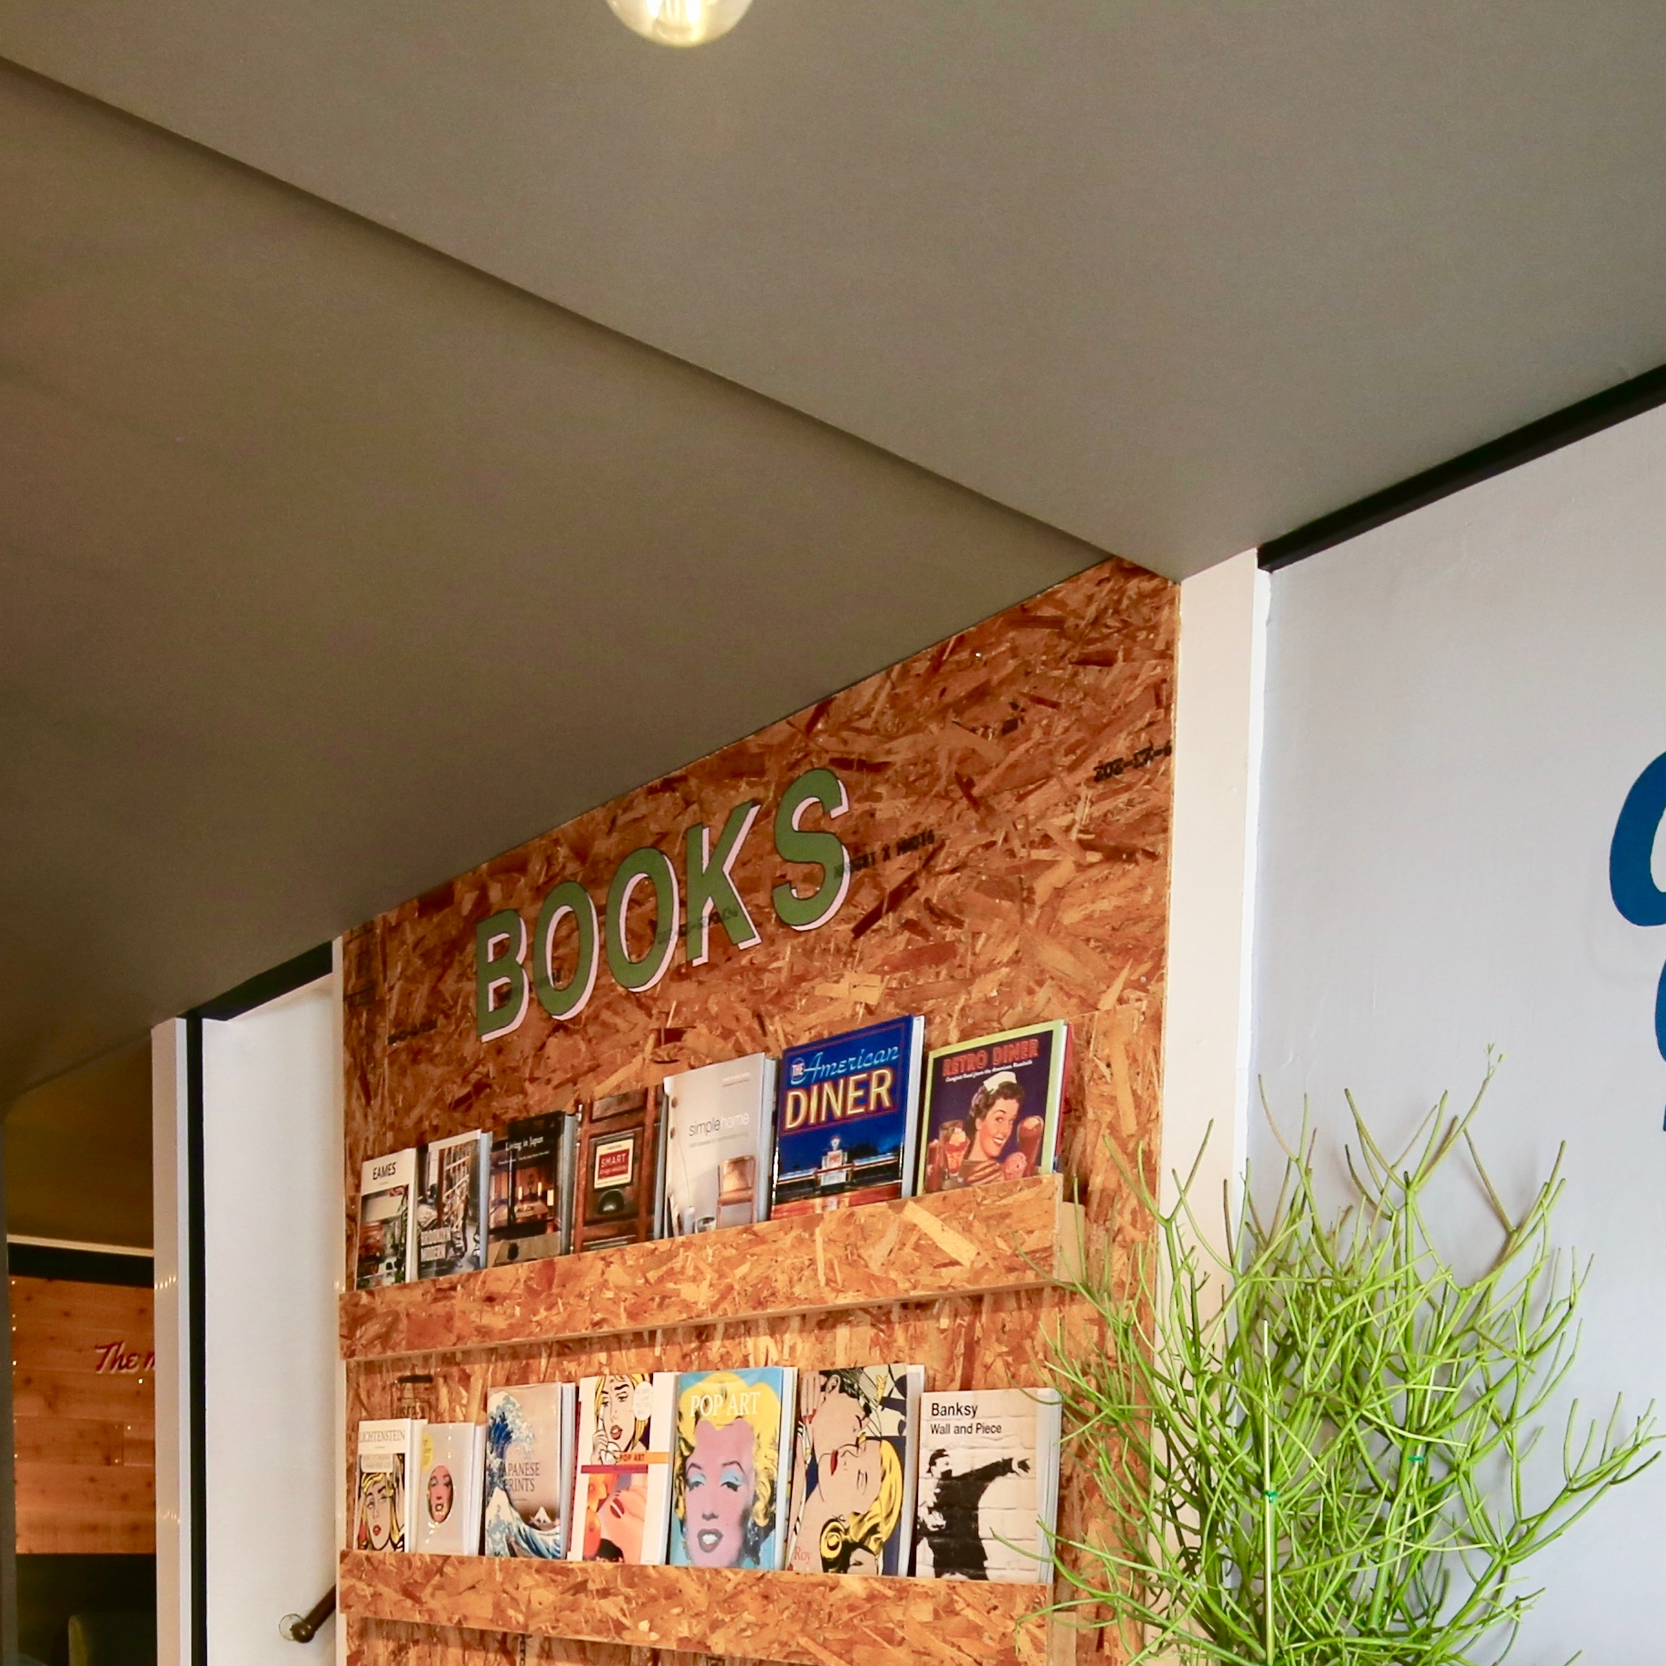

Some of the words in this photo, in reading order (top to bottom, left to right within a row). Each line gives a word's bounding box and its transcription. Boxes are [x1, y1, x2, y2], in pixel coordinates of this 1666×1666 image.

[476, 767, 850, 1043] BOOKS
[804, 1044, 899, 1082] American
[942, 1049, 988, 1077] RETRO
[992, 1039, 1040, 1066] DINER
[785, 1066, 894, 1130] DINER
[373, 1161, 397, 1180] EAMES
[600, 1152, 627, 1168] SMART
[94, 1340, 140, 1374] The
[688, 1393, 724, 1418] POP
[727, 1391, 761, 1415] ART
[930, 1401, 978, 1422] Banksy
[929, 1421, 951, 1435] Wall
[953, 1421, 973, 1435] and
[975, 1421, 1003, 1436] Piece
[619, 1453, 632, 1462] POP
[633, 1453, 645, 1462] ART
